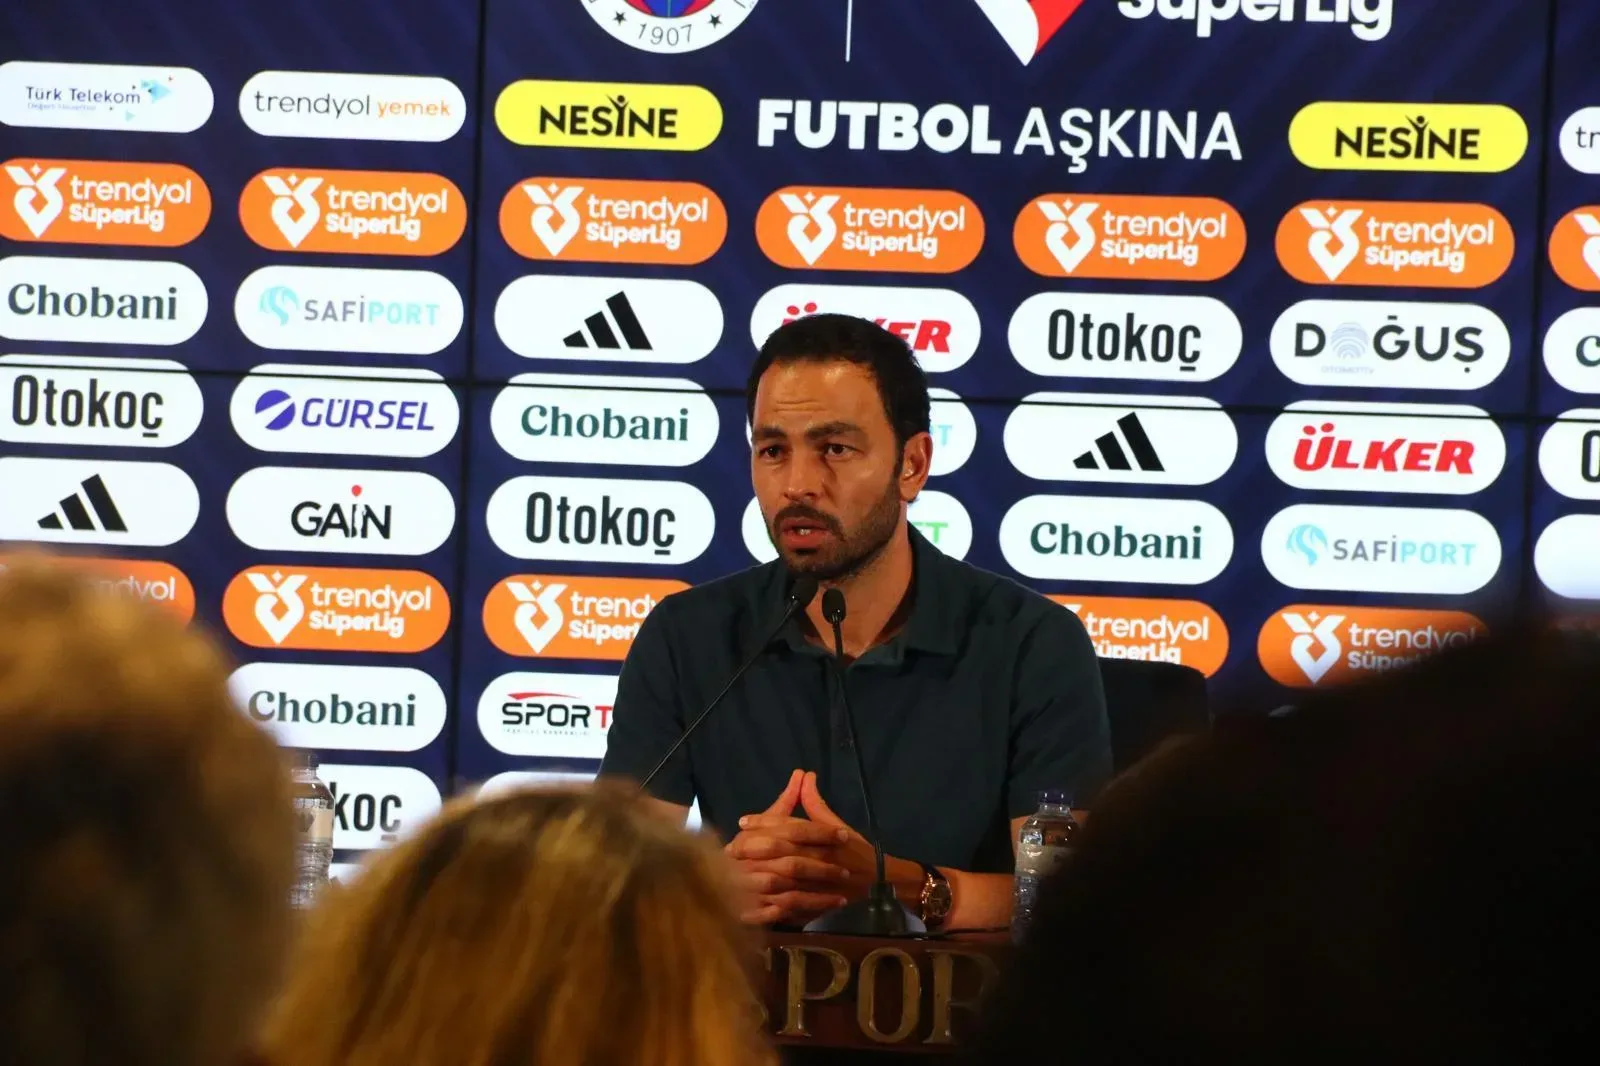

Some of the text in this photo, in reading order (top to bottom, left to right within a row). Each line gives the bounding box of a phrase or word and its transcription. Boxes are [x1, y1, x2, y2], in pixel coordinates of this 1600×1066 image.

[638, 24, 692, 46] 1907
[26, 86, 141, 104] Türk Telekom
[254, 91, 450, 119] trendyol yemek
[757, 99, 1243, 174] FUTBOL AŞKINA
[70, 175, 192, 210] trendyol
[326, 185, 448, 220] trendyol
[69, 205, 165, 232] SüperLig
[325, 212, 421, 242] SüperLig
[586, 195, 709, 229] trendyol
[843, 204, 966, 239] trendyol
[1102, 211, 1227, 246] trendyol
[585, 223, 682, 251] SüperLig
[842, 232, 939, 260] SüperLig
[1366, 217, 1495, 253] trendyol
[1101, 239, 1199, 267] SüperLig
[1365, 245, 1466, 274] SüperLig
[8, 283, 177, 321] Chobani
[1047, 308, 1202, 372] Otokoç
[12, 374, 163, 438] Otokoç
[301, 397, 435, 431] GÜRSEL
[521, 404, 689, 442] Chobani
[1293, 422, 1475, 475] ÜLKER
[526, 491, 676, 556] Otokoç
[1030, 521, 1202, 560] Chobani
[310, 583, 432, 617] trendyol
[309, 610, 405, 638] SüperLig
[1084, 612, 1209, 645] trendyol
[248, 691, 416, 727] Chobani
